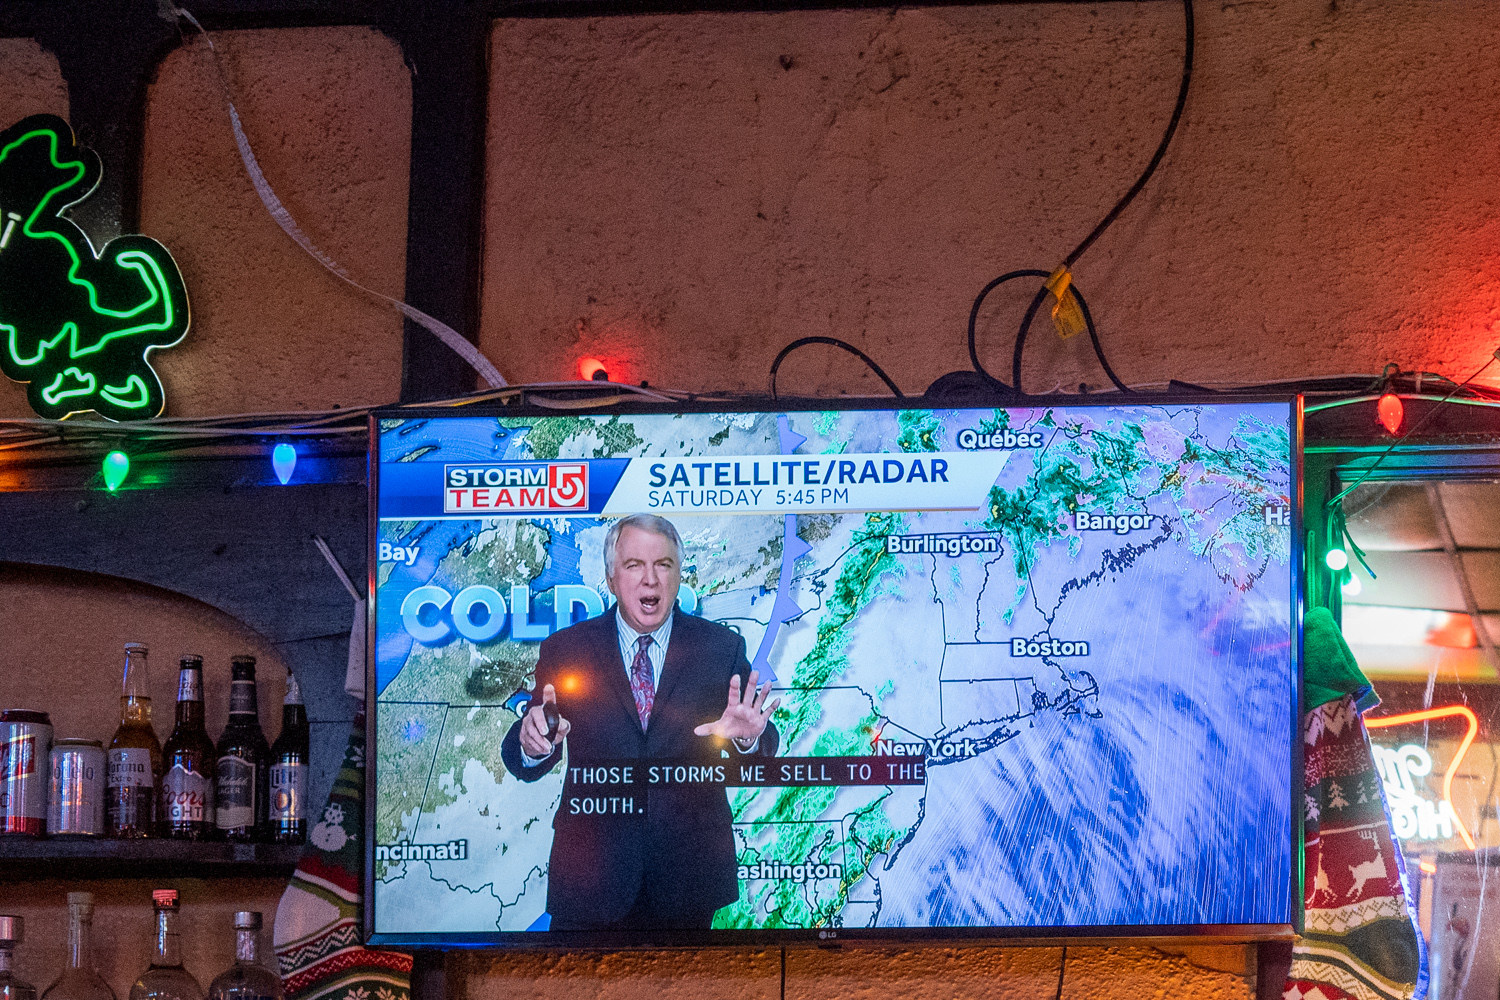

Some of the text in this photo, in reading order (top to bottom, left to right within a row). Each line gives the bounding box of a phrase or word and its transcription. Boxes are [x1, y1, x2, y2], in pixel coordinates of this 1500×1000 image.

[958, 429, 1042, 449] Québec
[450, 467, 546, 487] STORM
[648, 458, 949, 488] SATELLITE/RADAR
[450, 465, 585, 508] TEAM 5
[648, 488, 848, 508] SATURDAY 5:45 PM
[1075, 512, 1154, 534] Bangor
[379, 543, 419, 565] Bay
[887, 535, 997, 556] Burlington
[1012, 639, 1088, 658] Boston
[877, 740, 977, 756] New York
[570, 763, 926, 785] THOSE STORMS WE SELL TO THE
[570, 798, 644, 815] SOUTH.
